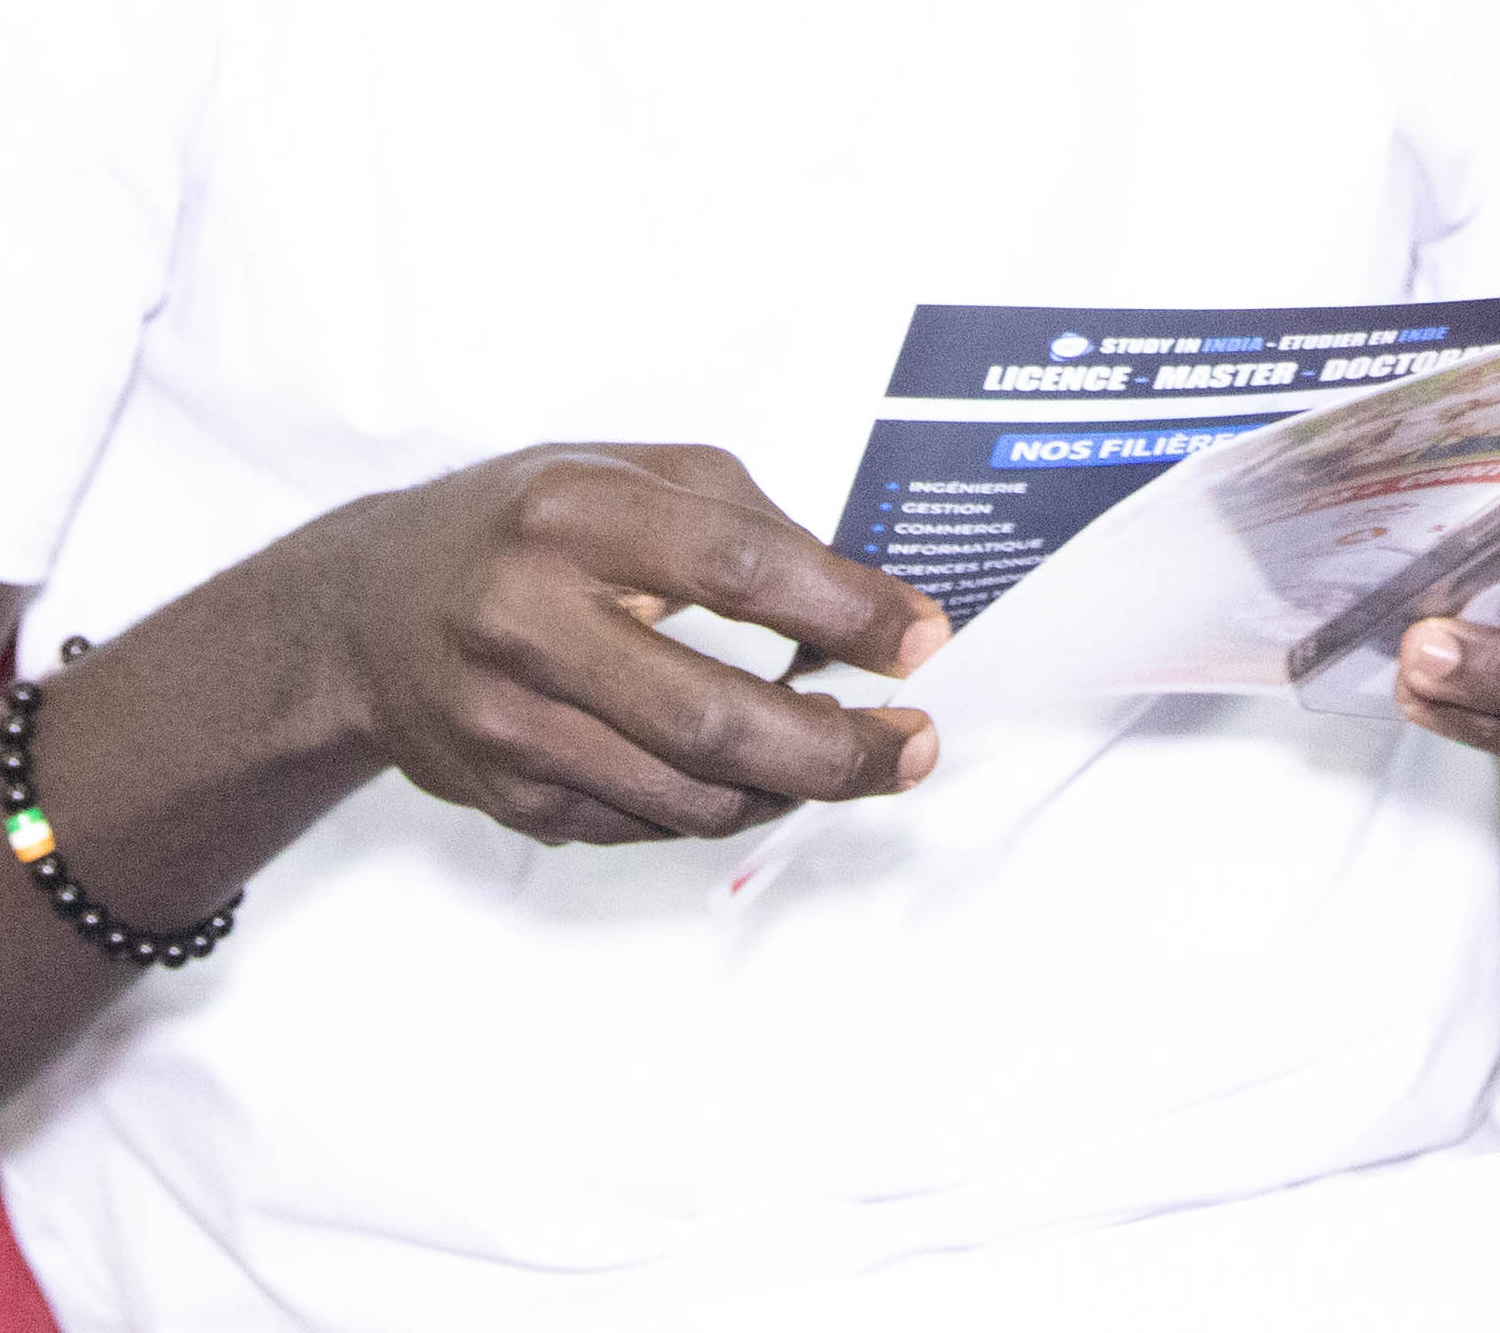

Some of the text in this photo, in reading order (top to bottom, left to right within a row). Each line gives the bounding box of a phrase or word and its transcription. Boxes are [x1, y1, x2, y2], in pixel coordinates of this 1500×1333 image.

[1100, 337, 1173, 354] STUDY
[1174, 337, 1201, 353] IN
[1202, 336, 1264, 353] INDIA
[1277, 332, 1367, 351] ETUDIER
[1368, 330, 1399, 347] EN
[983, 365, 1132, 391] LICENCE
[1152, 361, 1298, 390] MASTER
[1010, 439, 1093, 462] NOS
[908, 481, 1028, 495] INGÉNIERIE
[901, 502, 994, 515] GESTION
[894, 522, 1016, 535] COMMERCE
[887, 537, 1045, 556] INFORMATIQUE
[881, 562, 980, 576] SCIENCES
